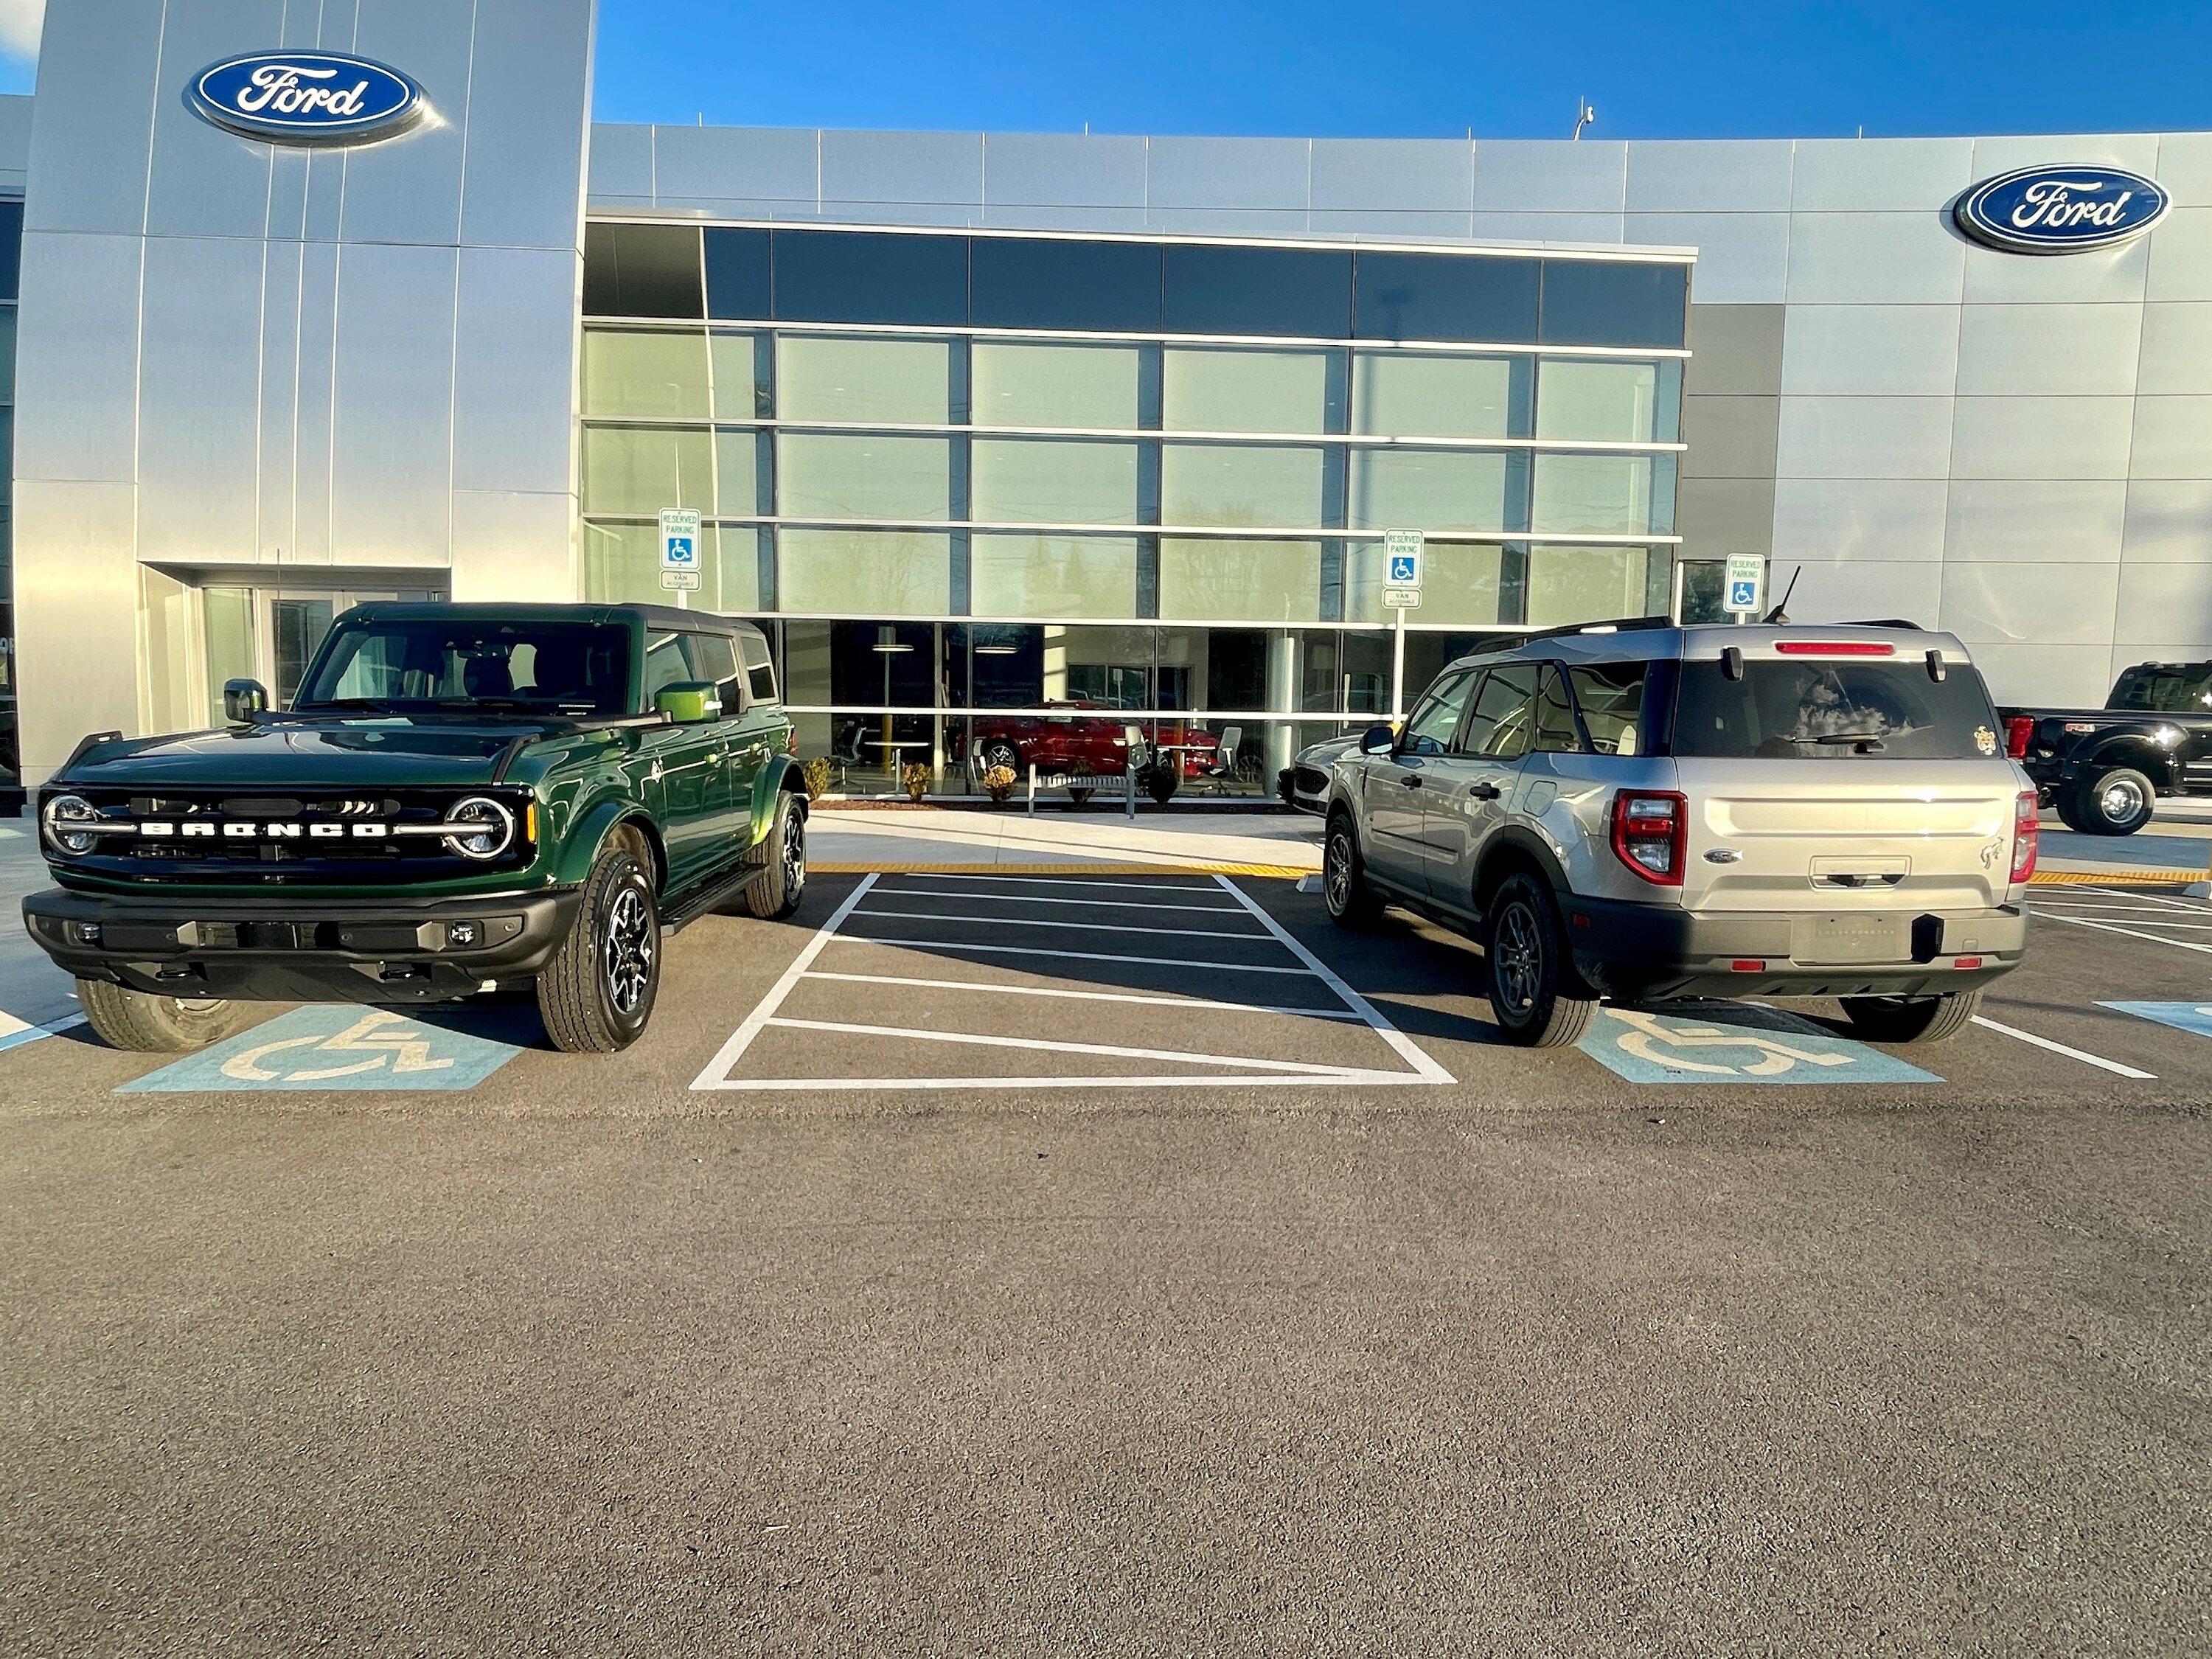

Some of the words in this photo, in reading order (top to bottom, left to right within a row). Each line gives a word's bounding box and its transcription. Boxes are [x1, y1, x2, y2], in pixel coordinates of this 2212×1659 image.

[237, 65, 369, 116] Ford
[2011, 181, 2133, 229] Ford
[663, 515, 697, 524] RESERVED
[666, 525, 695, 534] PARKING
[1388, 535, 1421, 543] RESERVED
[1391, 545, 1417, 553] PARKING
[1730, 560, 1761, 568] RESERVED
[1732, 570, 1758, 578] PARKING
[140, 823, 387, 837] BRONCO
